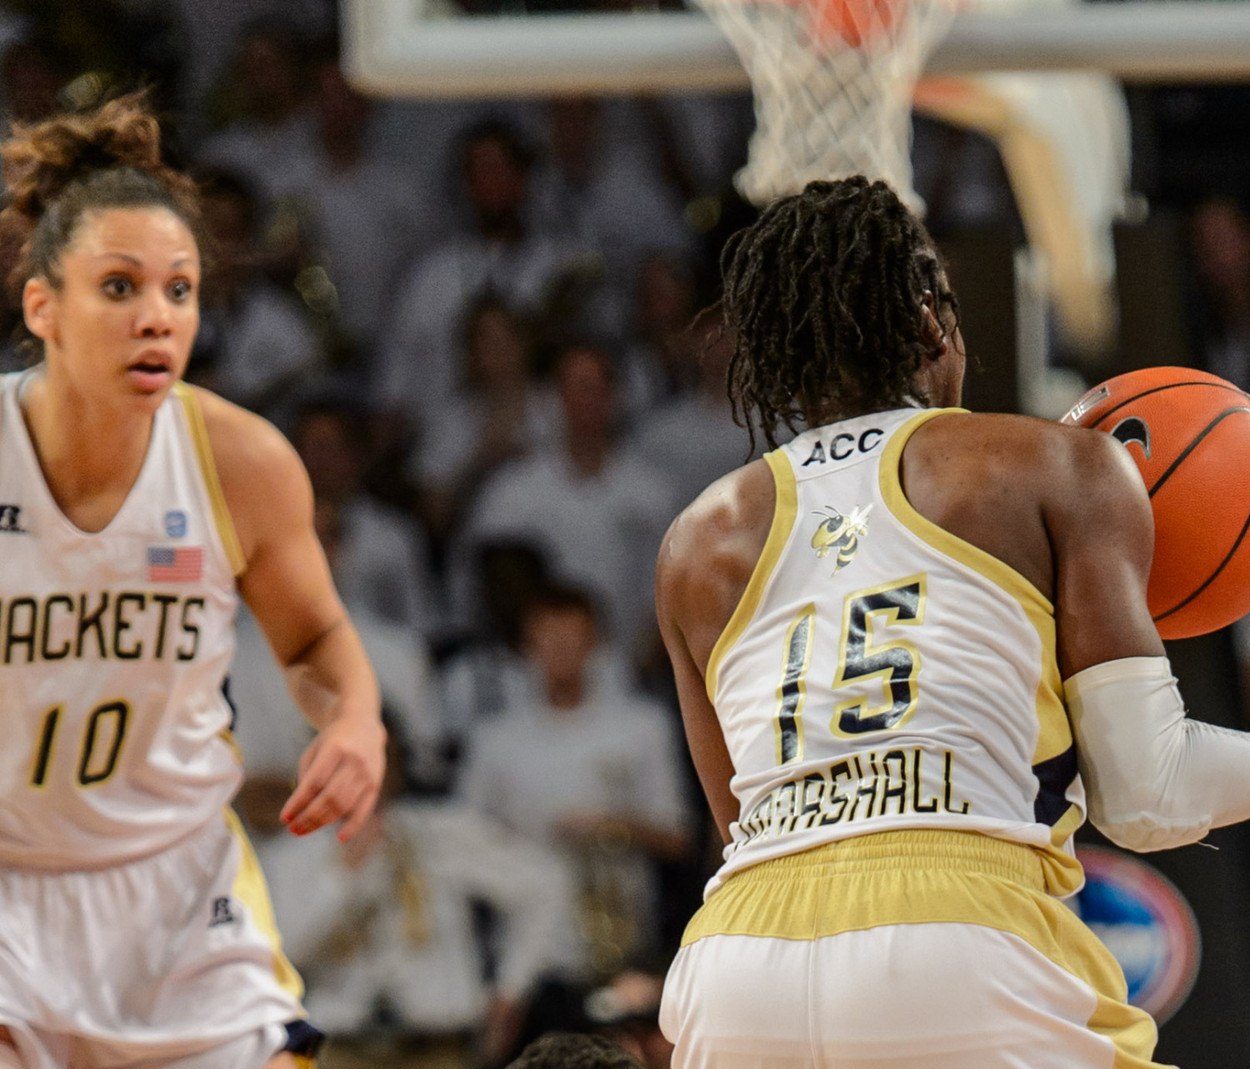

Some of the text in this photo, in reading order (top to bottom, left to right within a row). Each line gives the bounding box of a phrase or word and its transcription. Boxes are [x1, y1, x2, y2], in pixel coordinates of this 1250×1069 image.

[801, 428, 885, 467] ACC
[0, 591, 206, 664] ACKETS
[773, 571, 928, 767] 15
[29, 699, 133, 788] 10
